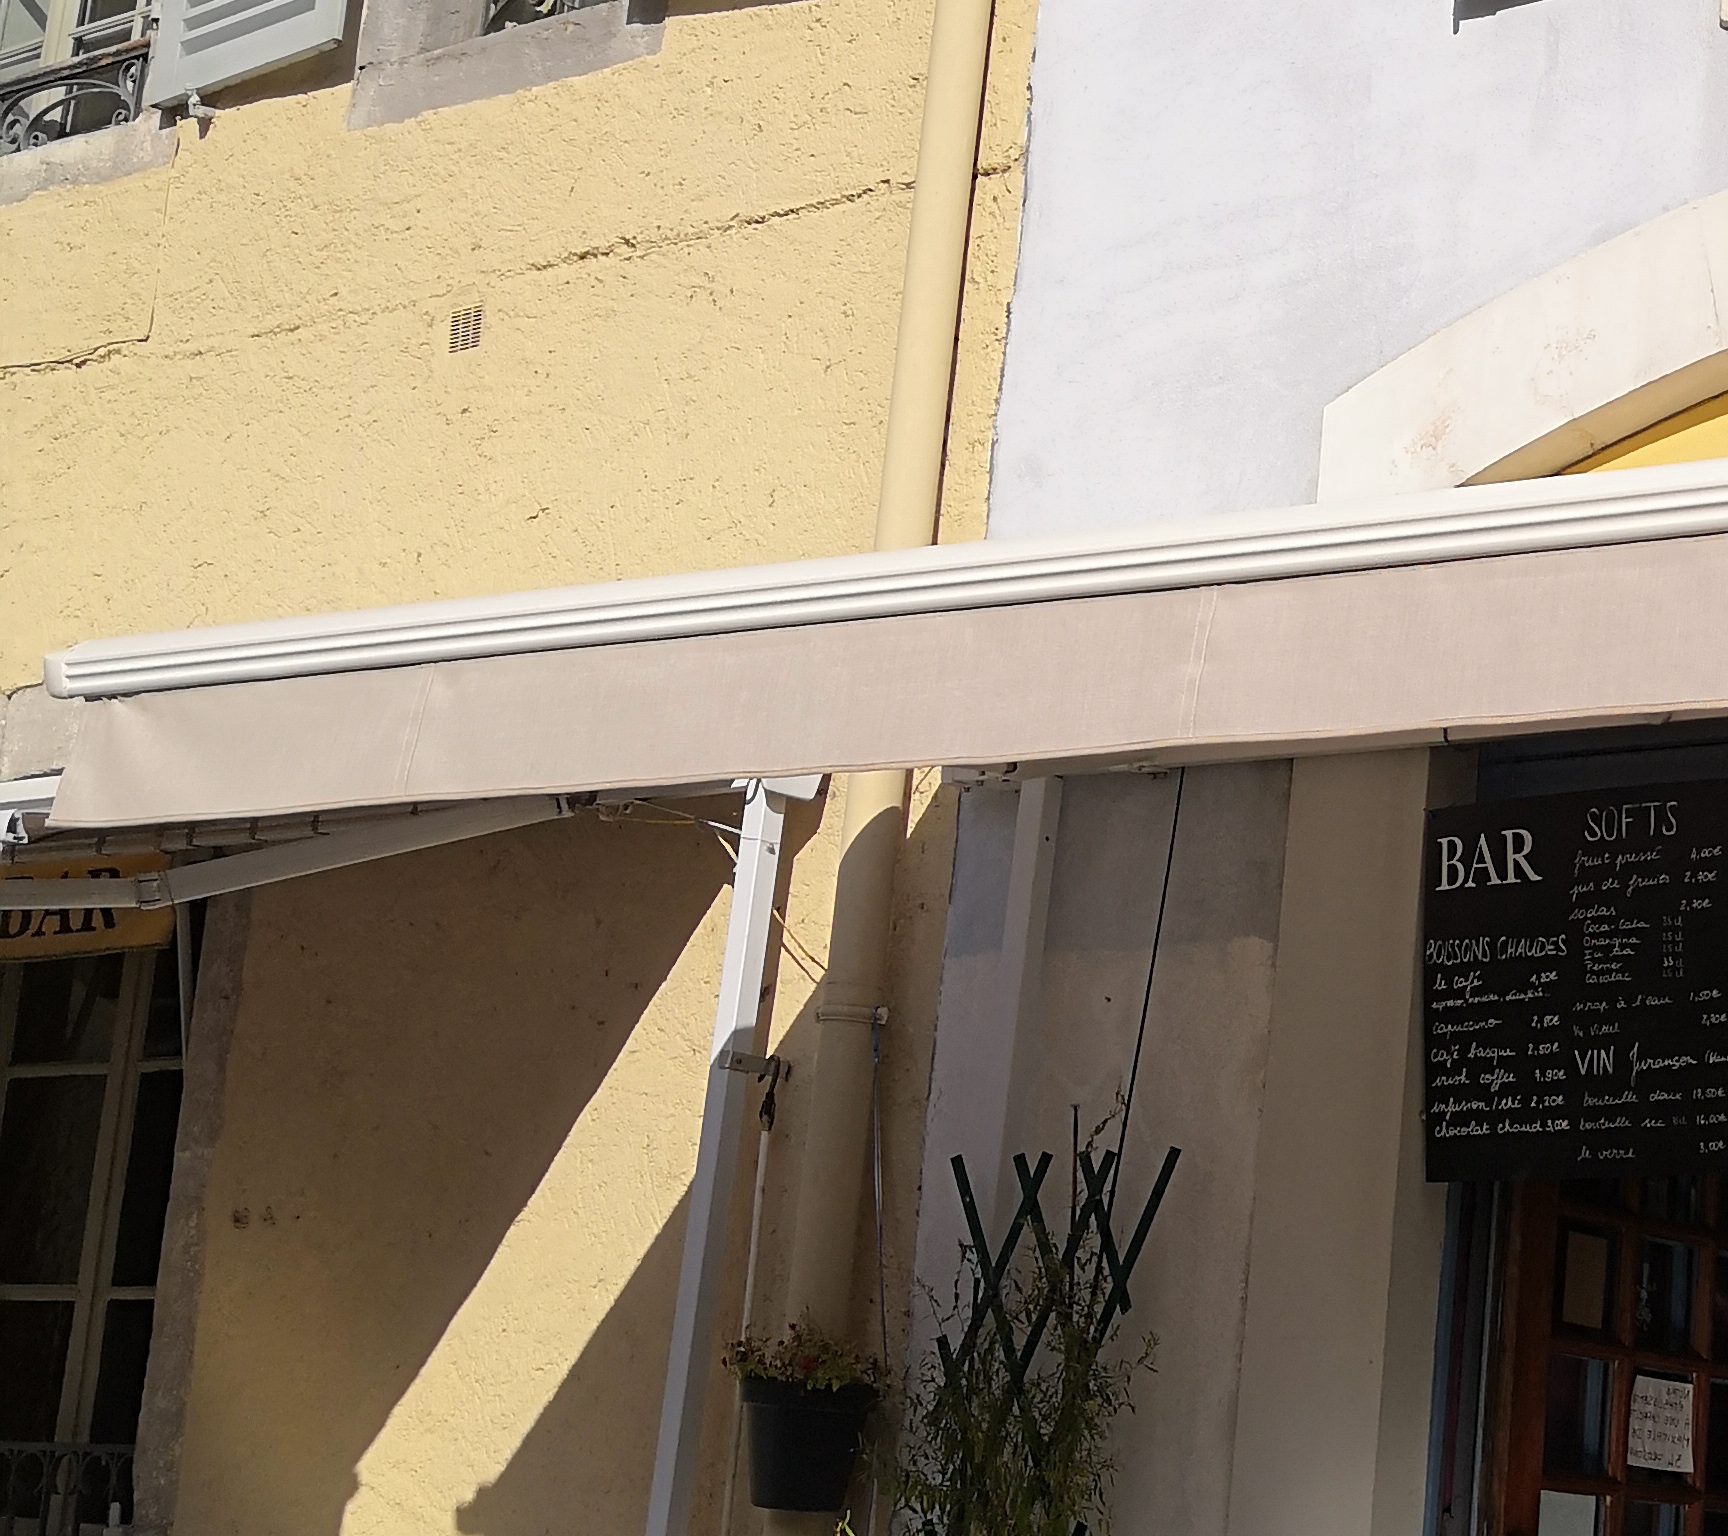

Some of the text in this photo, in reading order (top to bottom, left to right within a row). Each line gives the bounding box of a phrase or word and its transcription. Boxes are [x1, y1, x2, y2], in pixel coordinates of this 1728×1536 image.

[1584, 801, 1679, 842] SOFTS
[1435, 829, 1544, 892] BAR
[1574, 849, 1611, 877] fruit
[1615, 845, 1662, 872] pressé
[1569, 882, 1595, 902] jus
[1601, 877, 1621, 891] de
[1626, 873, 1671, 897] fruits
[1568, 904, 1617, 920] sodas
[1426, 934, 1567, 965] BOISSONS CHAUDES
[1583, 936, 1642, 948] Orangina
[1583, 960, 1623, 971] Perrier
[1433, 973, 1447, 990] le
[1453, 970, 1483, 999] café
[1572, 1000, 1610, 1014] sirop
[1616, 996, 1628, 1009] à
[1632, 994, 1674, 1007] l'eau
[1589, 1021, 1620, 1035] Vittel
[1431, 1045, 1460, 1068] café
[1467, 1041, 1516, 1066] basque
[1574, 1044, 1615, 1076] VIN
[1628, 1041, 1698, 1087] Jurançon
[1431, 1067, 1470, 1088] irish
[1479, 1068, 1517, 1092] coffee
[1583, 1090, 1639, 1107] bouteille
[1648, 1089, 1683, 1102] doux
[1434, 1120, 1491, 1138] chocolat
[1497, 1118, 1543, 1134] chaud
[1579, 1116, 1632, 1131] bouteille
[1641, 1117, 1666, 1128] sec
[1577, 1145, 1592, 1162] le
[1597, 1146, 1636, 1160] verre
